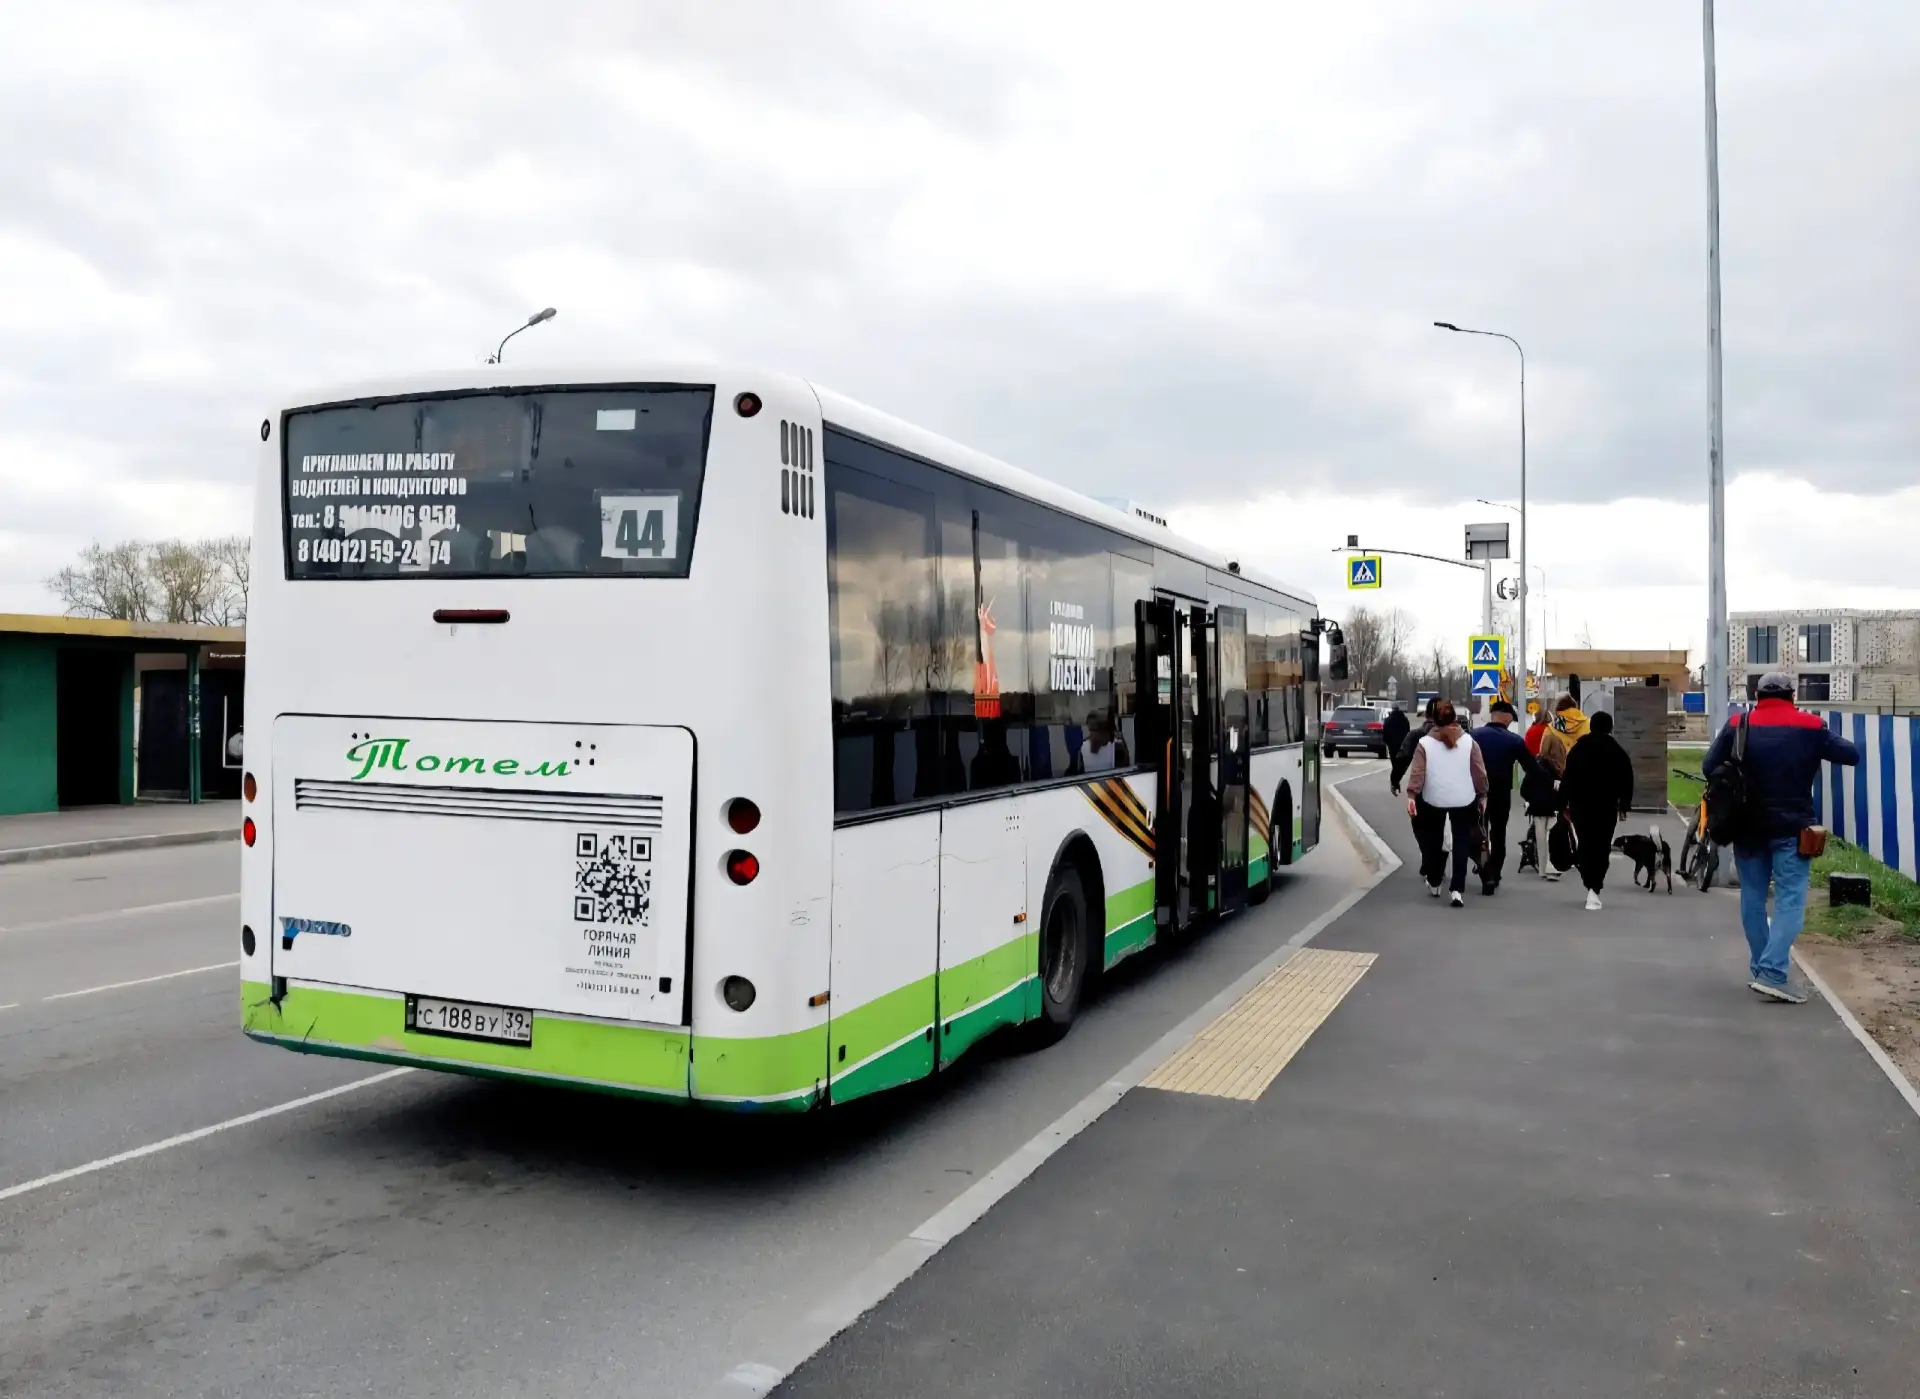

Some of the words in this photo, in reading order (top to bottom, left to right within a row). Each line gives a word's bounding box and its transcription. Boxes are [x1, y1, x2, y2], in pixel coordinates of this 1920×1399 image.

[302, 453, 384, 473] ПРИГЛАШАЕМ
[386, 453, 403, 472] НА
[405, 452, 455, 472] РАБОТУ
[292, 476, 360, 498] ВОДИТЕЛЕЙ
[362, 478, 372, 496] И
[372, 477, 467, 498] КОНДУКТОРОВ
[323, 504, 335, 529] 8
[615, 509, 665, 557] 44
[298, 538, 309, 563] 8
[312, 538, 367, 563] (4012)
[346, 738, 572, 780] Тотем
[583, 928, 637, 945] ГОРЯЧАЯ
[587, 944, 631, 959] ЛИНИЯ
[505, 1011, 524, 1031] 39
